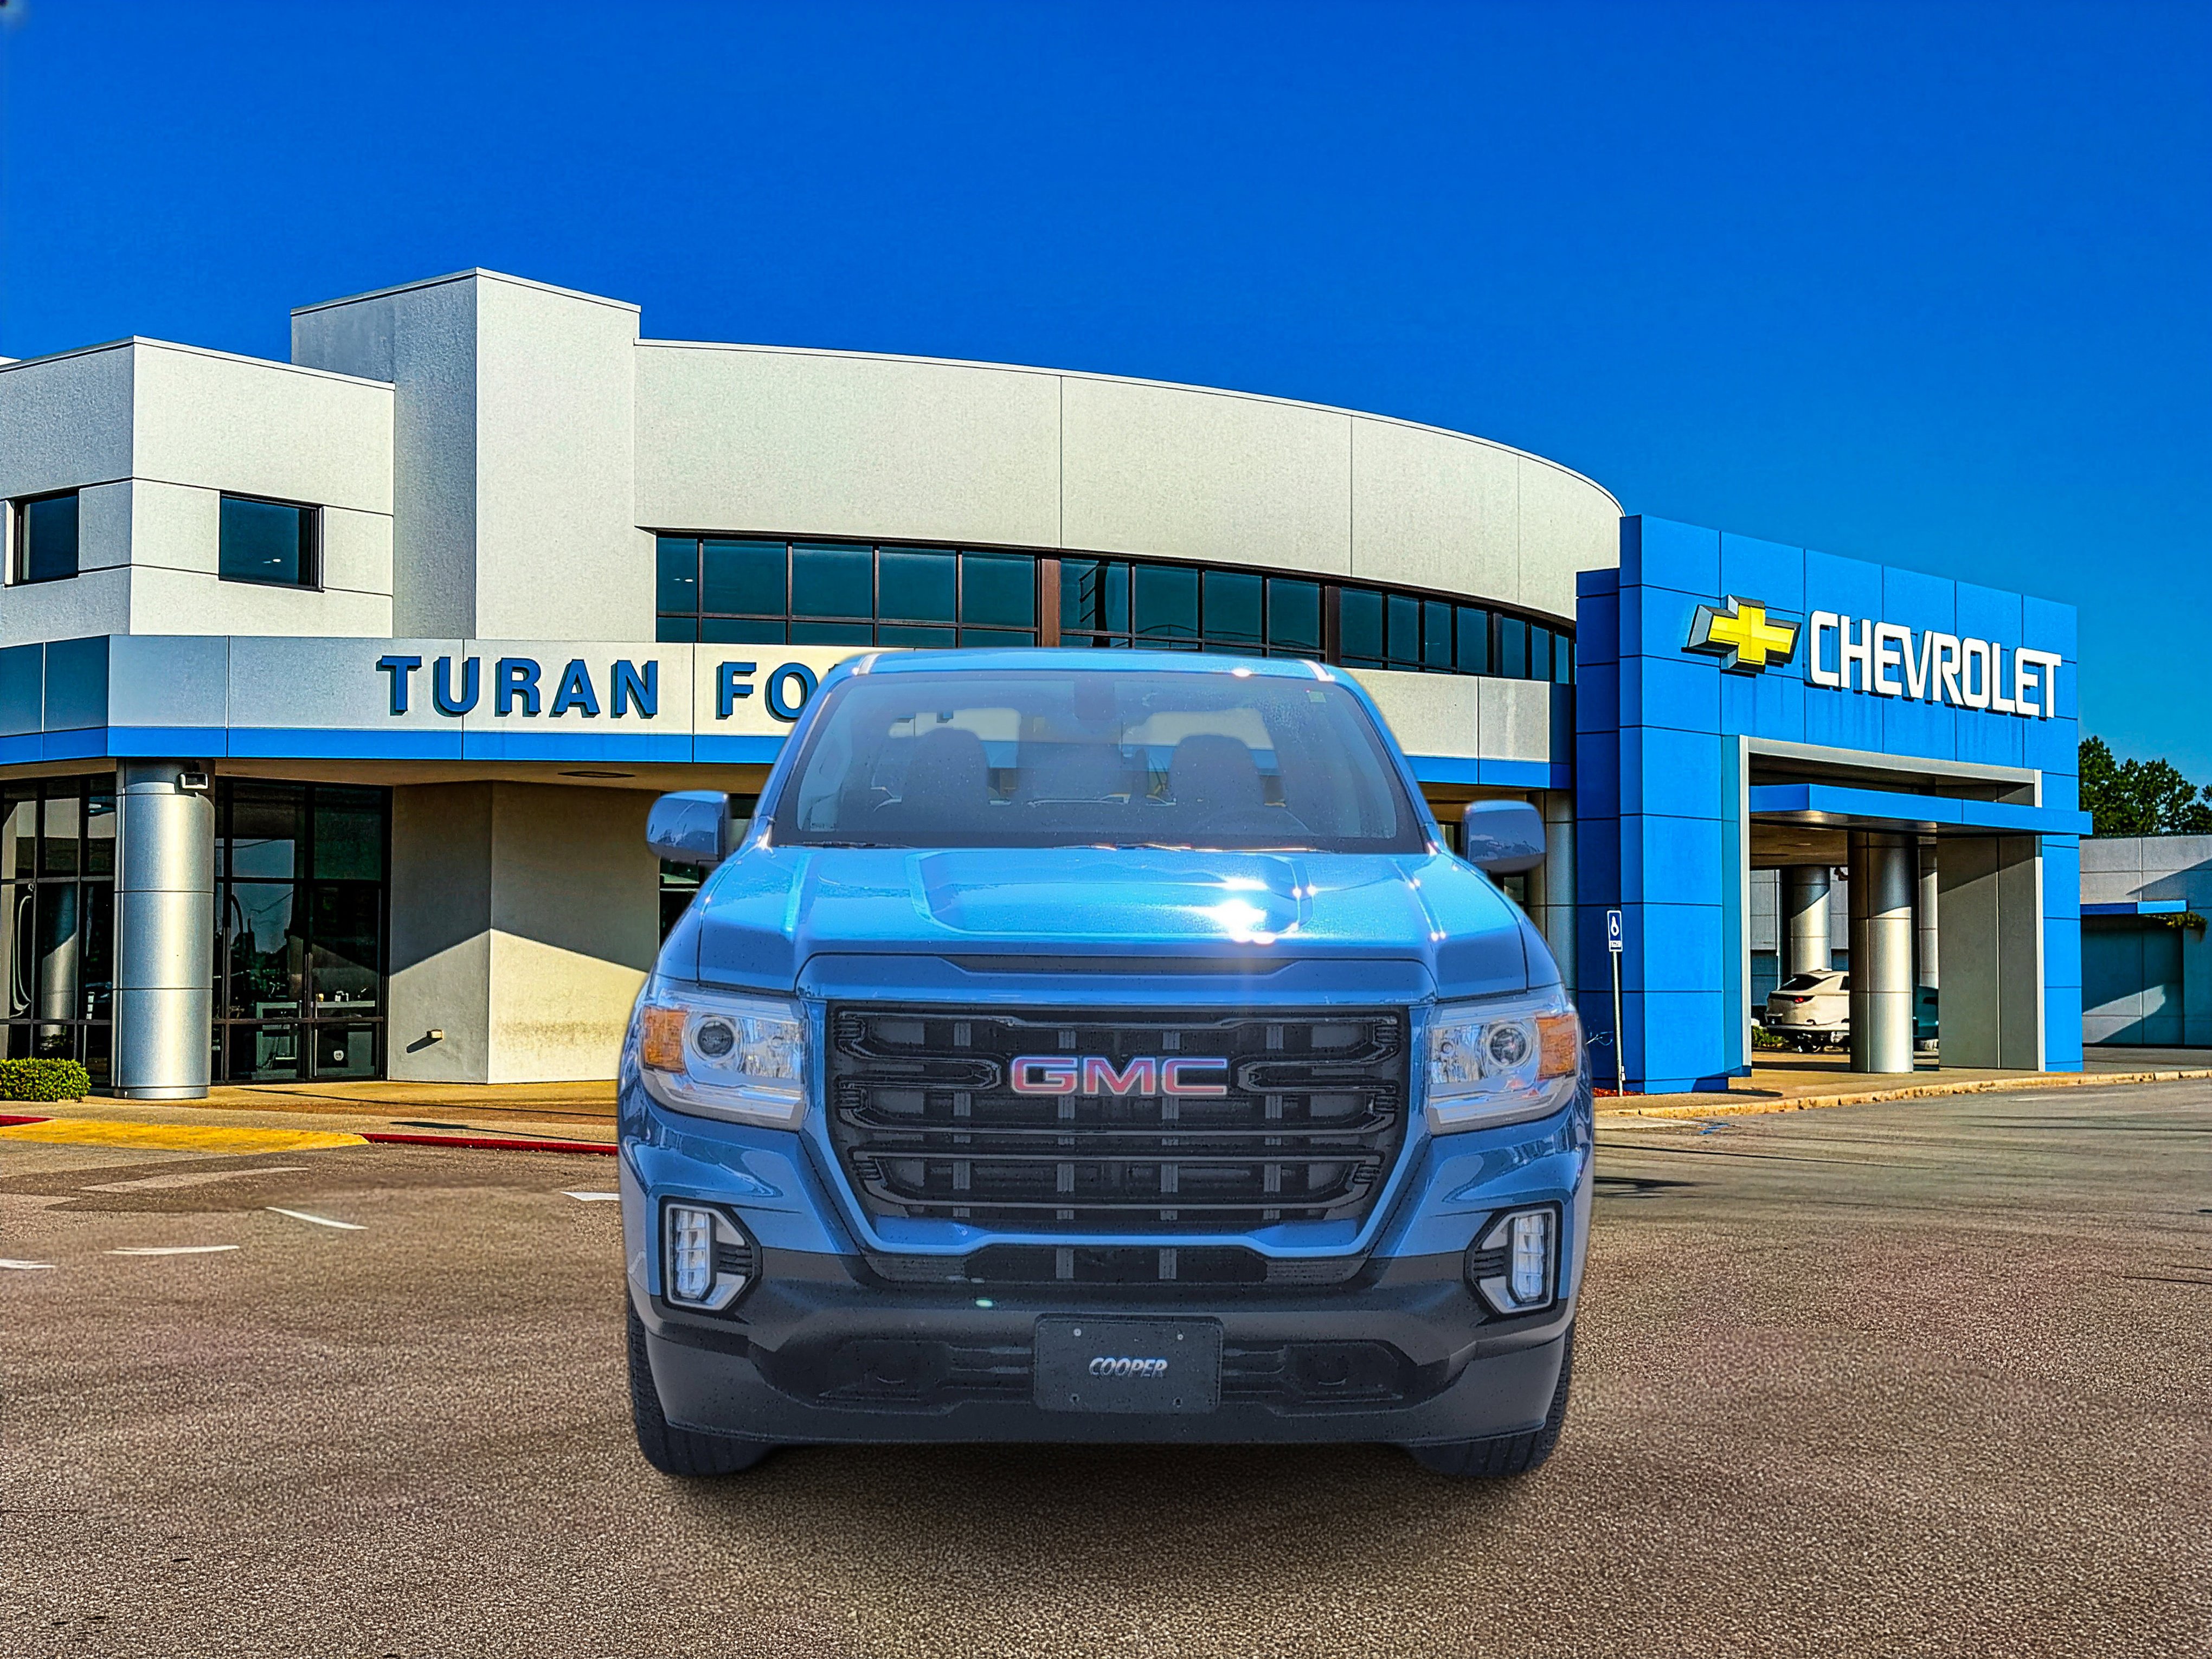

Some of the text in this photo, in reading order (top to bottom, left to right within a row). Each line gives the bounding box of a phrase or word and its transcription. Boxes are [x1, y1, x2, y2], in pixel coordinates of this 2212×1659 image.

[376, 655, 839, 723] TURAN FO
[1809, 610, 2062, 718] CHEVROLET
[1011, 1056, 1228, 1096] GMC
[1089, 1357, 1168, 1378] COOPER
